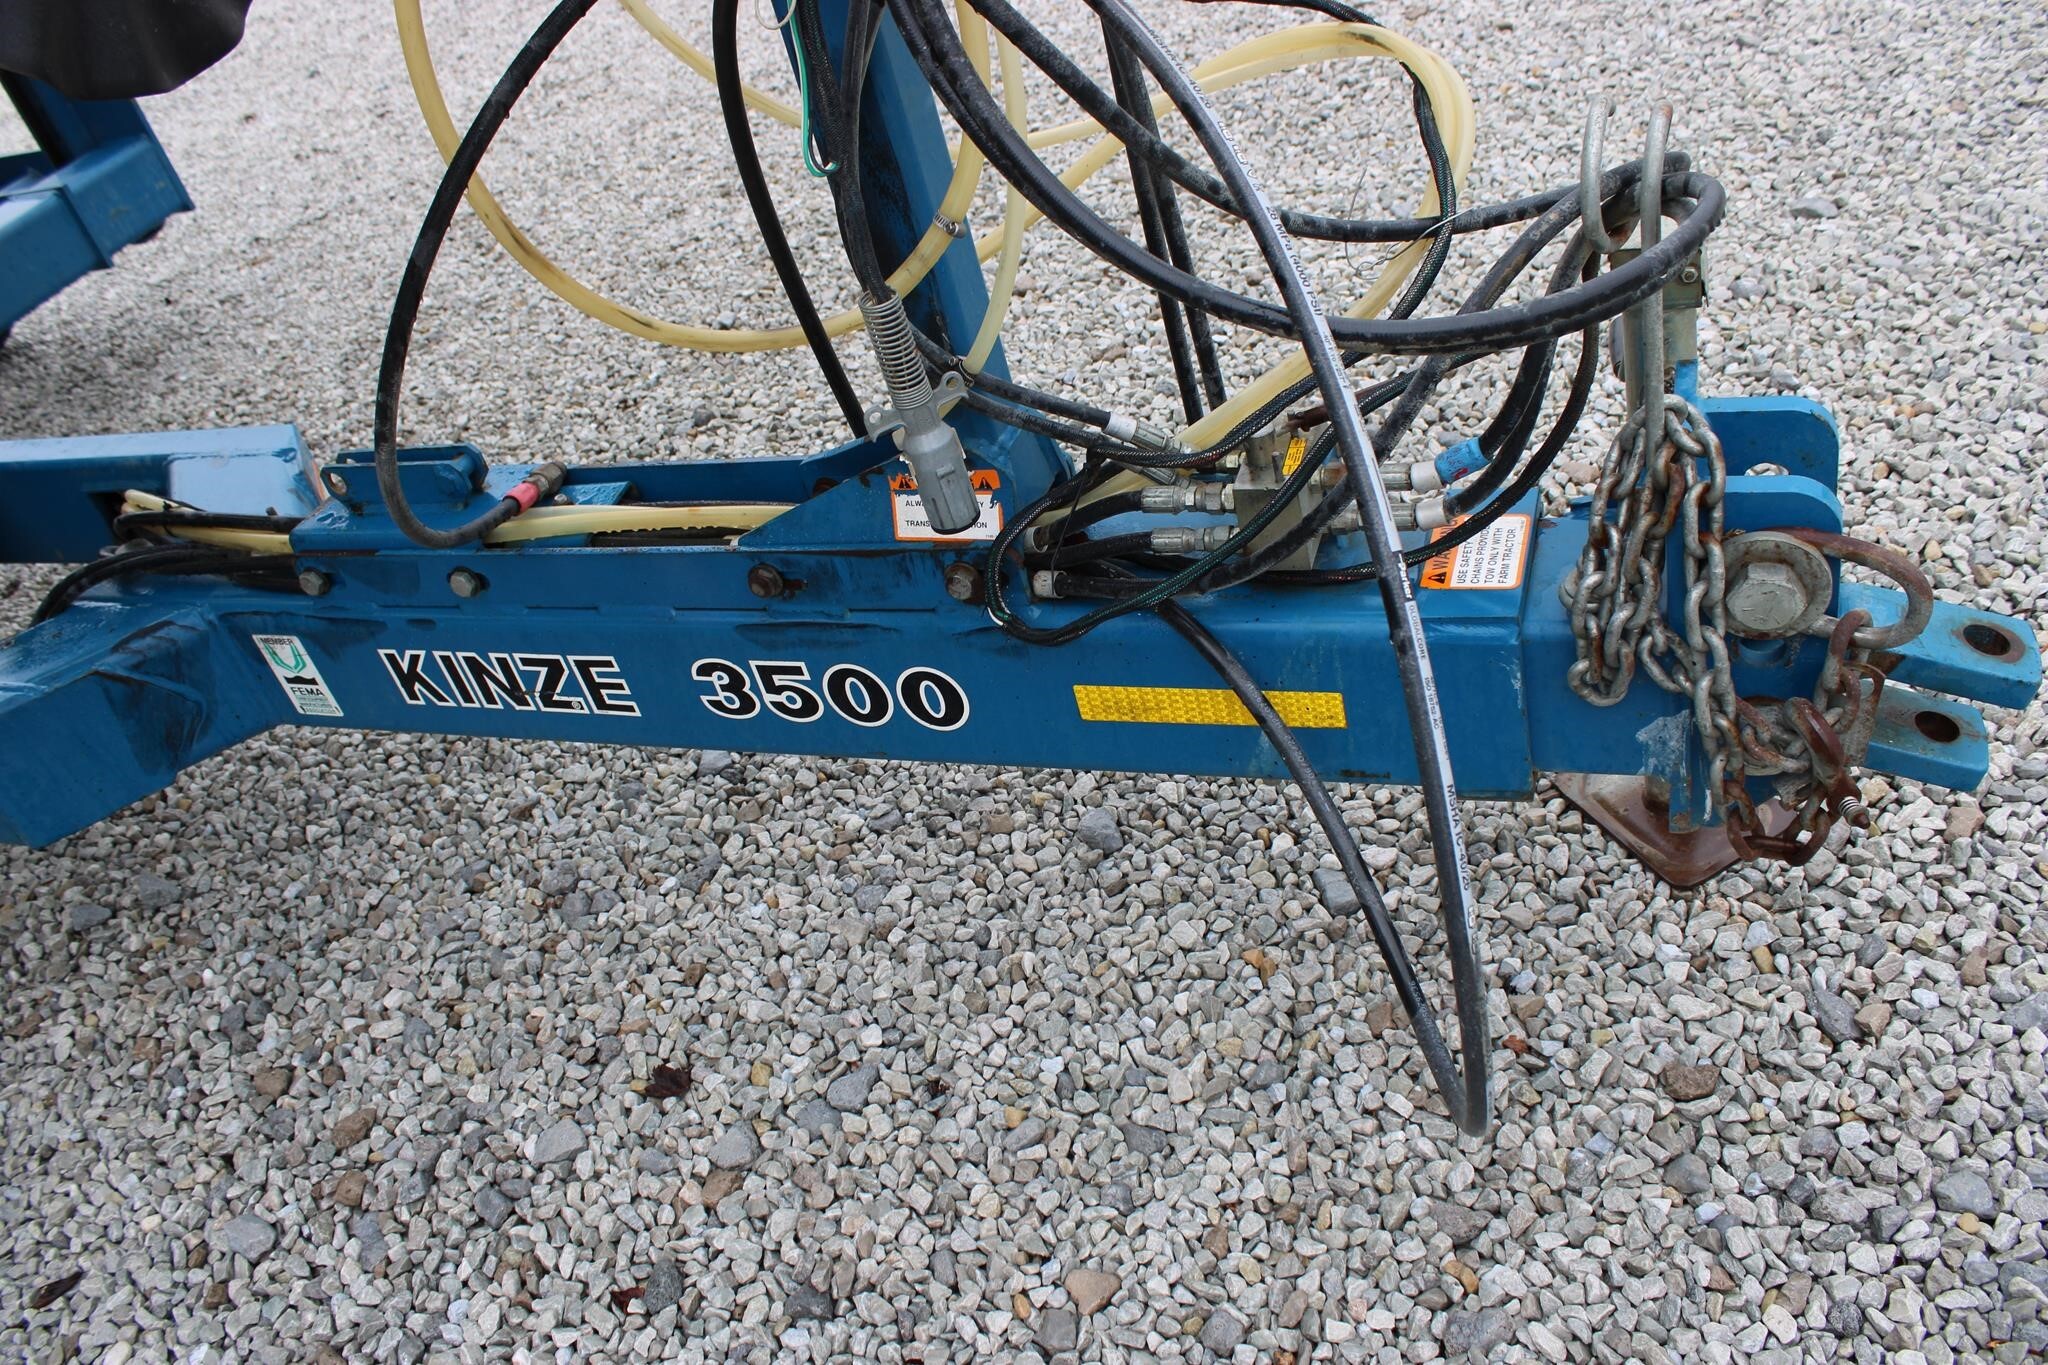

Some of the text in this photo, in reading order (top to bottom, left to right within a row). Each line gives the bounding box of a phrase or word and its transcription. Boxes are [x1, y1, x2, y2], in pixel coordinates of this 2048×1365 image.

[1456, 541, 1474, 584] USE SAFETY
[1470, 557, 1484, 584] CHAINS
[1484, 527, 1503, 584] TOW ONLY WITH
[1498, 528, 1517, 584] FARM TRACTOR
[290, 686, 325, 696] FEMA
[377, 649, 970, 731] KINZE 3500
[1447, 784, 1460, 828] MSHA
